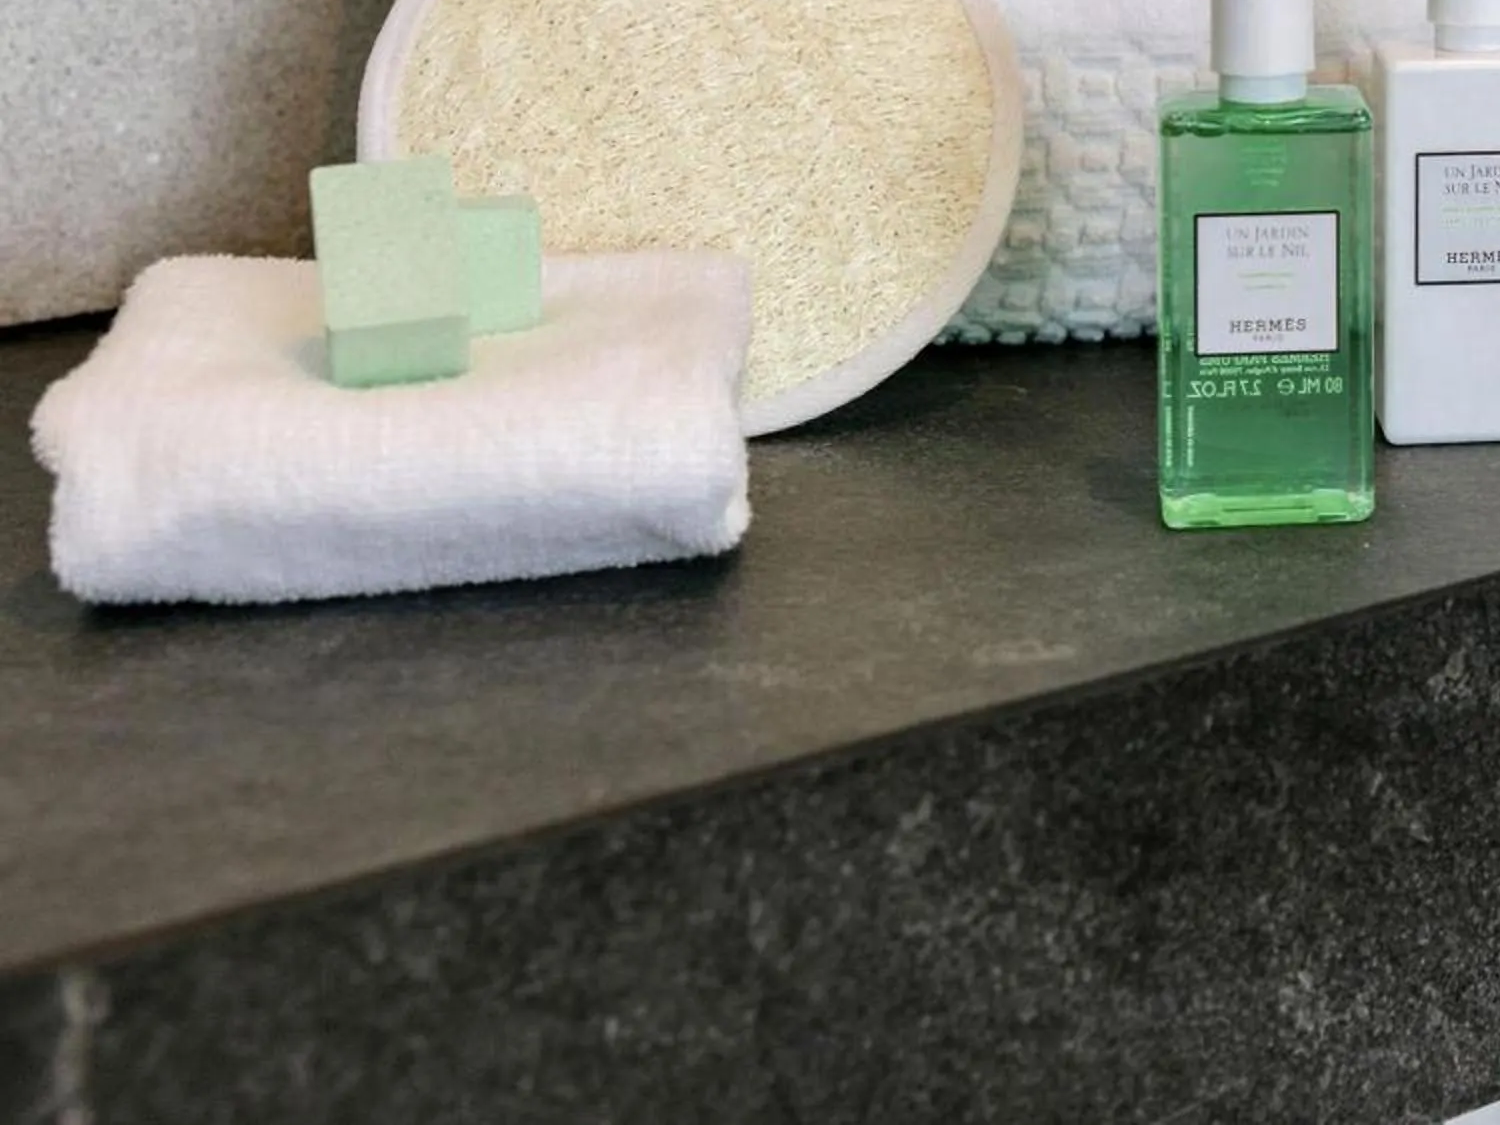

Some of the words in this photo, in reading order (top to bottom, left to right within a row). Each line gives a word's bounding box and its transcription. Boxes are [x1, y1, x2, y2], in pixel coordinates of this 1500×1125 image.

[1443, 165, 1465, 178] UN
[1444, 181, 1470, 194] SUR
[1474, 181, 1490, 194] LE
